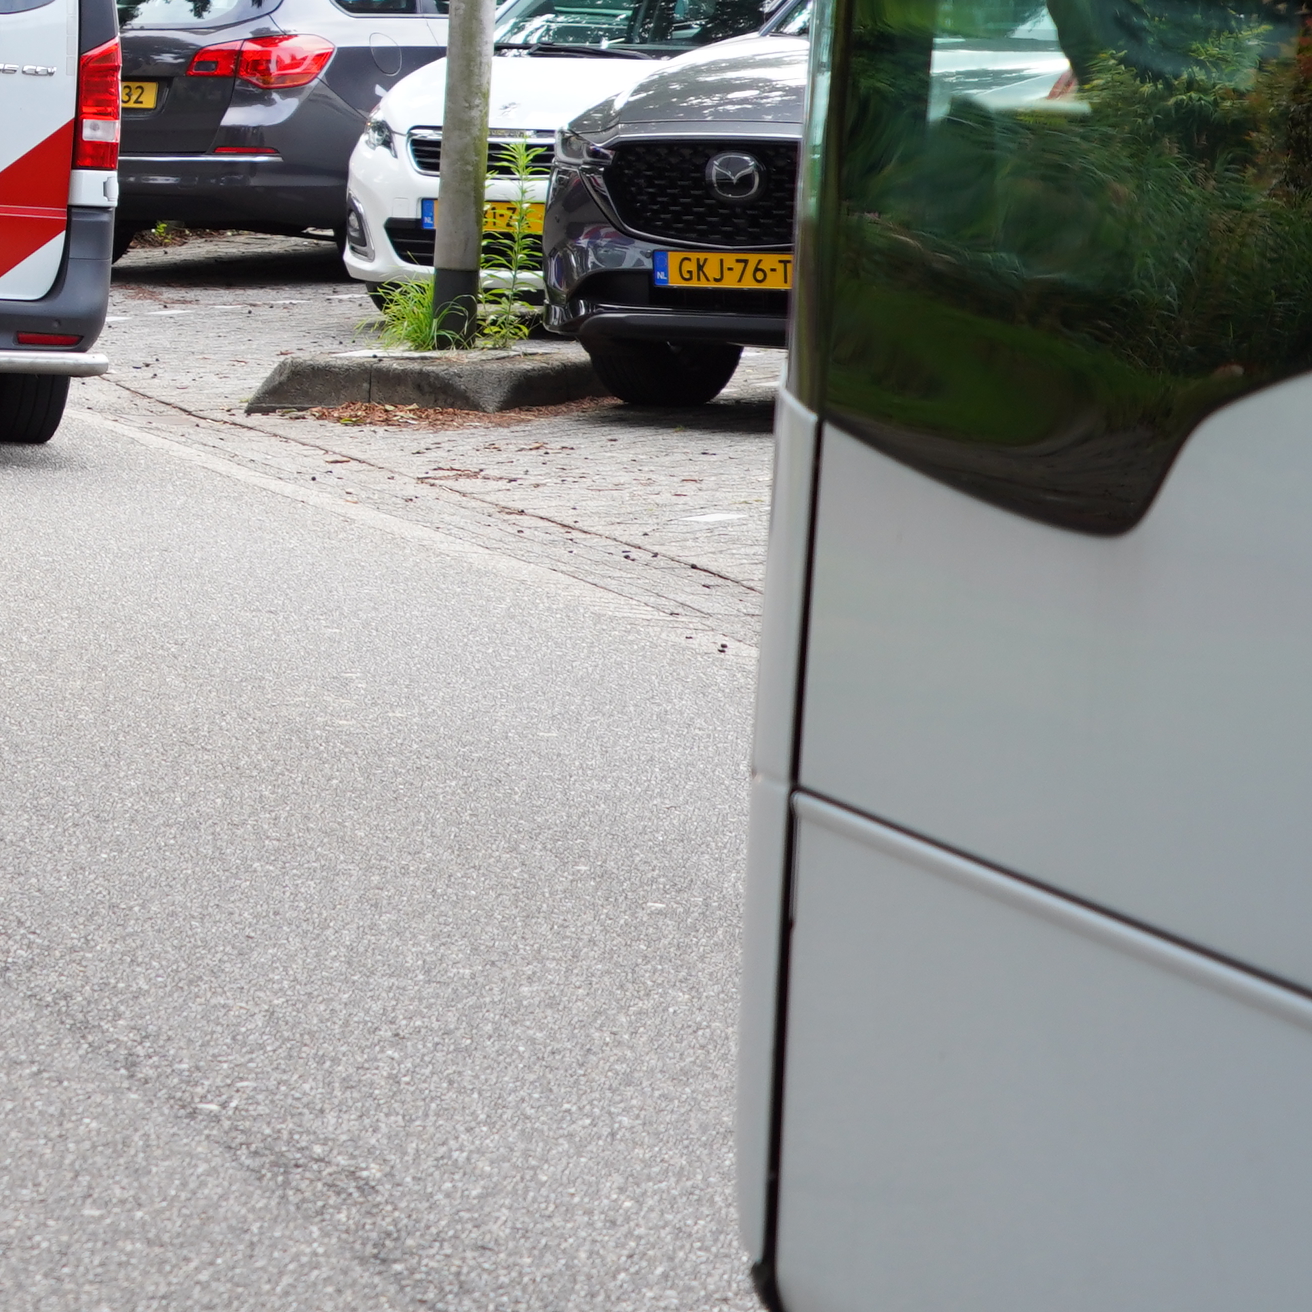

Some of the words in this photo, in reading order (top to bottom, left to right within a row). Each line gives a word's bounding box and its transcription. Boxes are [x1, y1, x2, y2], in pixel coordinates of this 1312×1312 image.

[424, 216, 433, 224] NL
[678, 256, 792, 284] GKJ-76-T
[657, 271, 667, 280] NL
